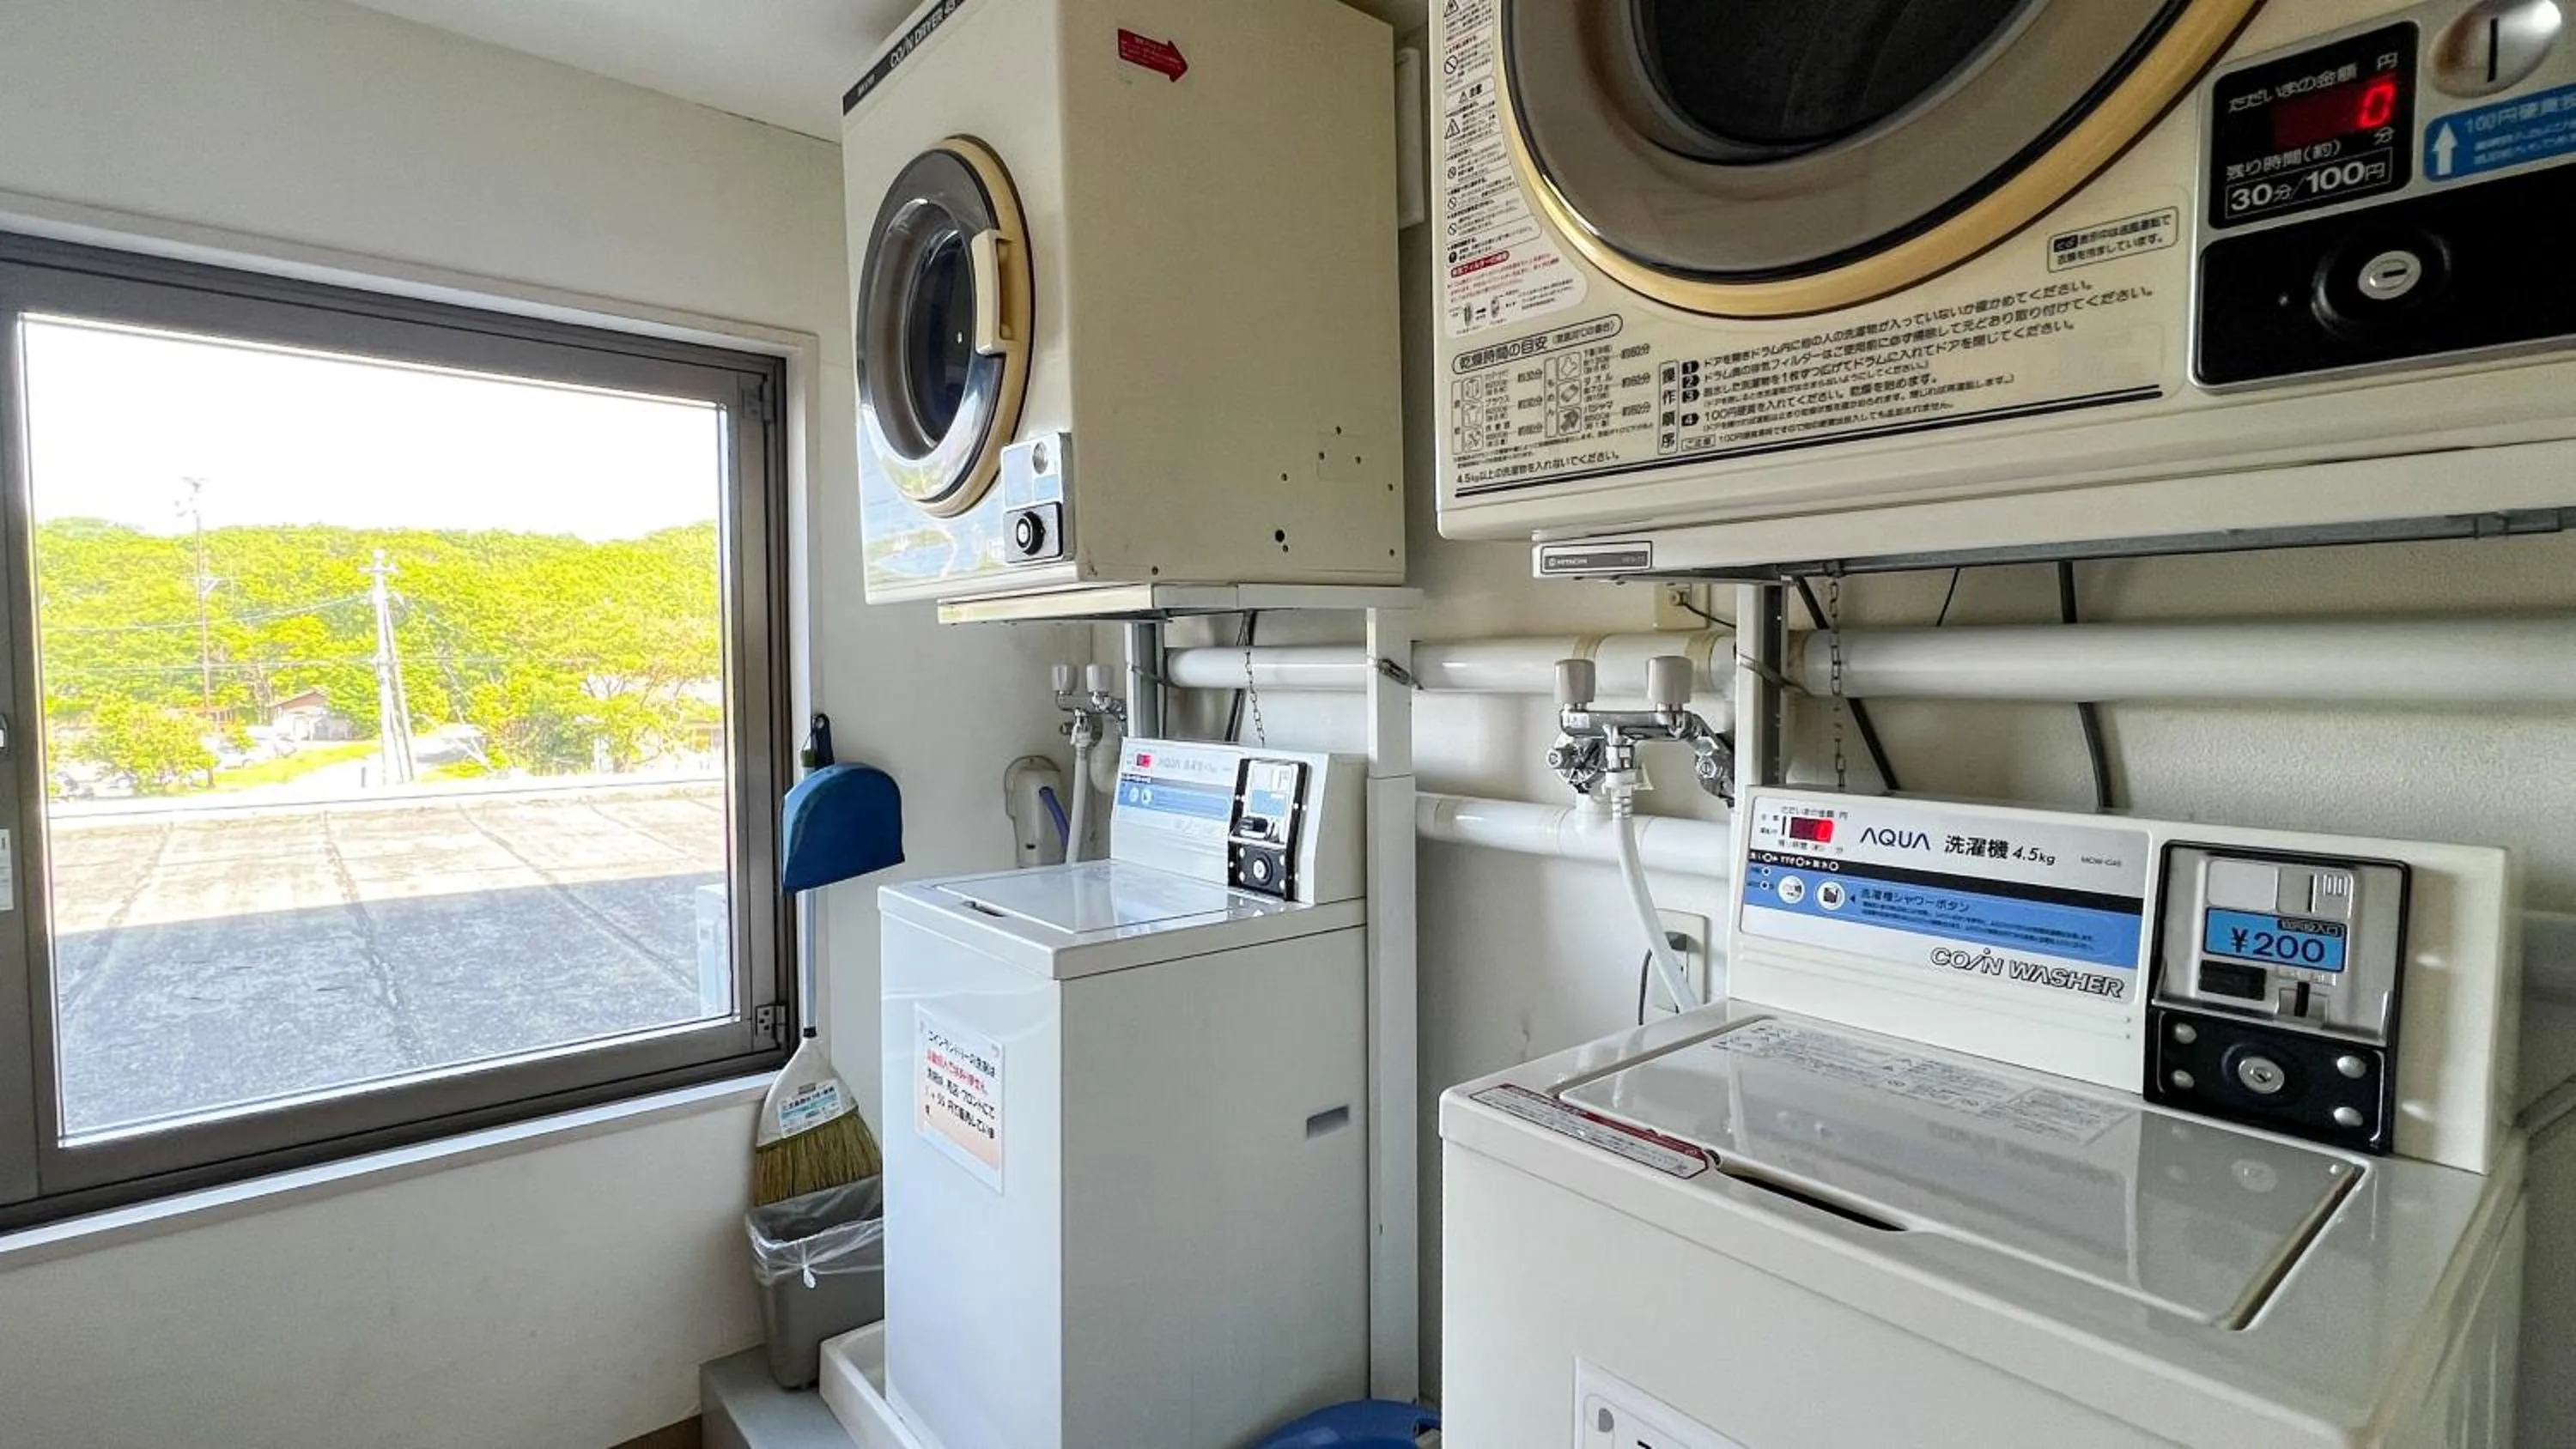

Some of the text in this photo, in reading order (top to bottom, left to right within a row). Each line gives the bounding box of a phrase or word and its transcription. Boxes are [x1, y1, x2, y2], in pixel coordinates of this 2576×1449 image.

[2229, 52, 2398, 113] ただいまの金額 円
[2361, 82, 2396, 127] 0
[2374, 127, 2395, 145] 分
[1860, 827, 2056, 865] AQUA 洗濯機 4.5kg
[1861, 888, 1970, 912] 洗濯機シャワーボタン
[2231, 927, 2325, 963] ¥200
[1931, 948, 2125, 997] COIN WASHER
